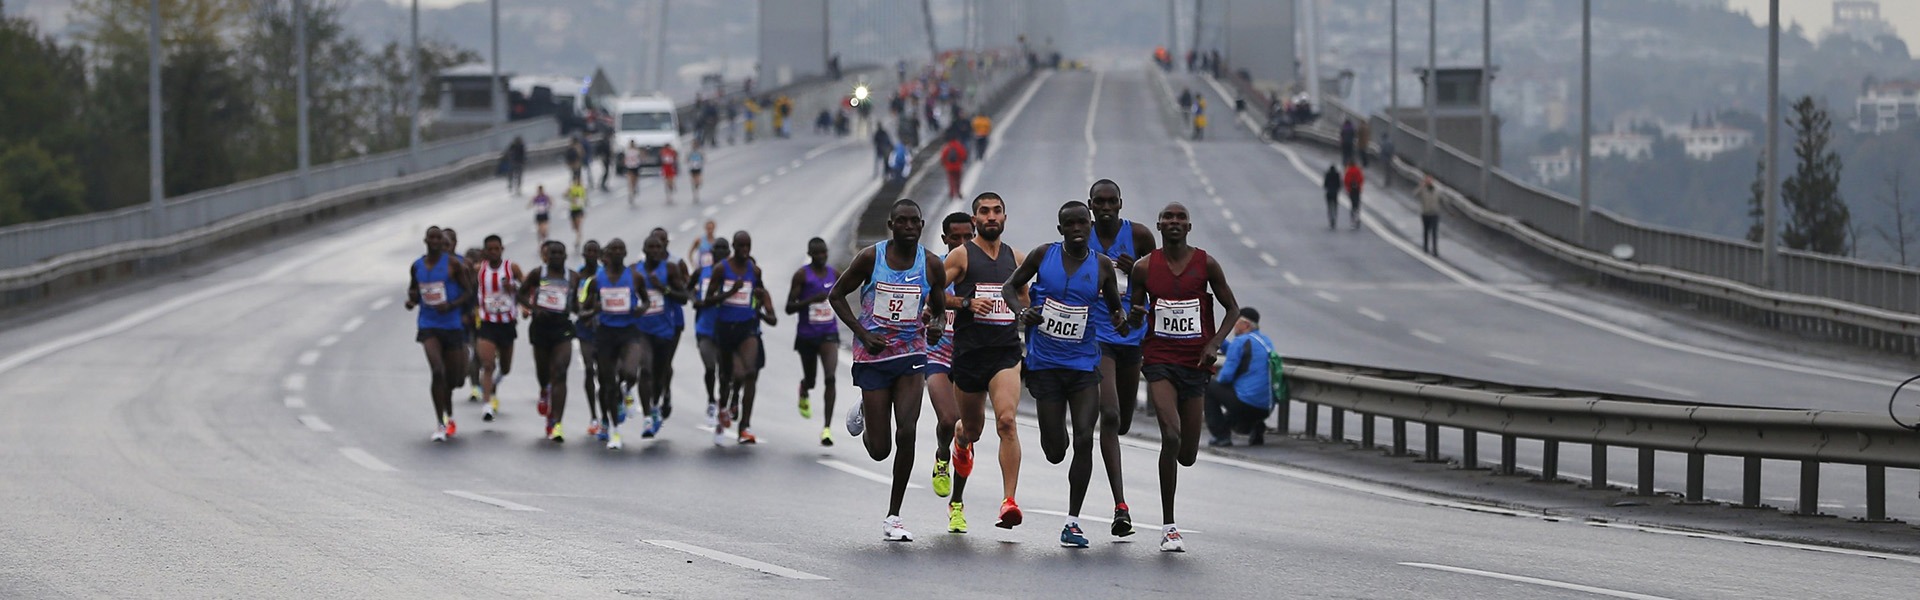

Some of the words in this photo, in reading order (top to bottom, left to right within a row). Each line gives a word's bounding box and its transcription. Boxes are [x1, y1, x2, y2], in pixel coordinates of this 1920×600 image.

[888, 299, 903, 312] 52
[1046, 318, 1079, 336] PACE
[1163, 317, 1194, 332] PACE
